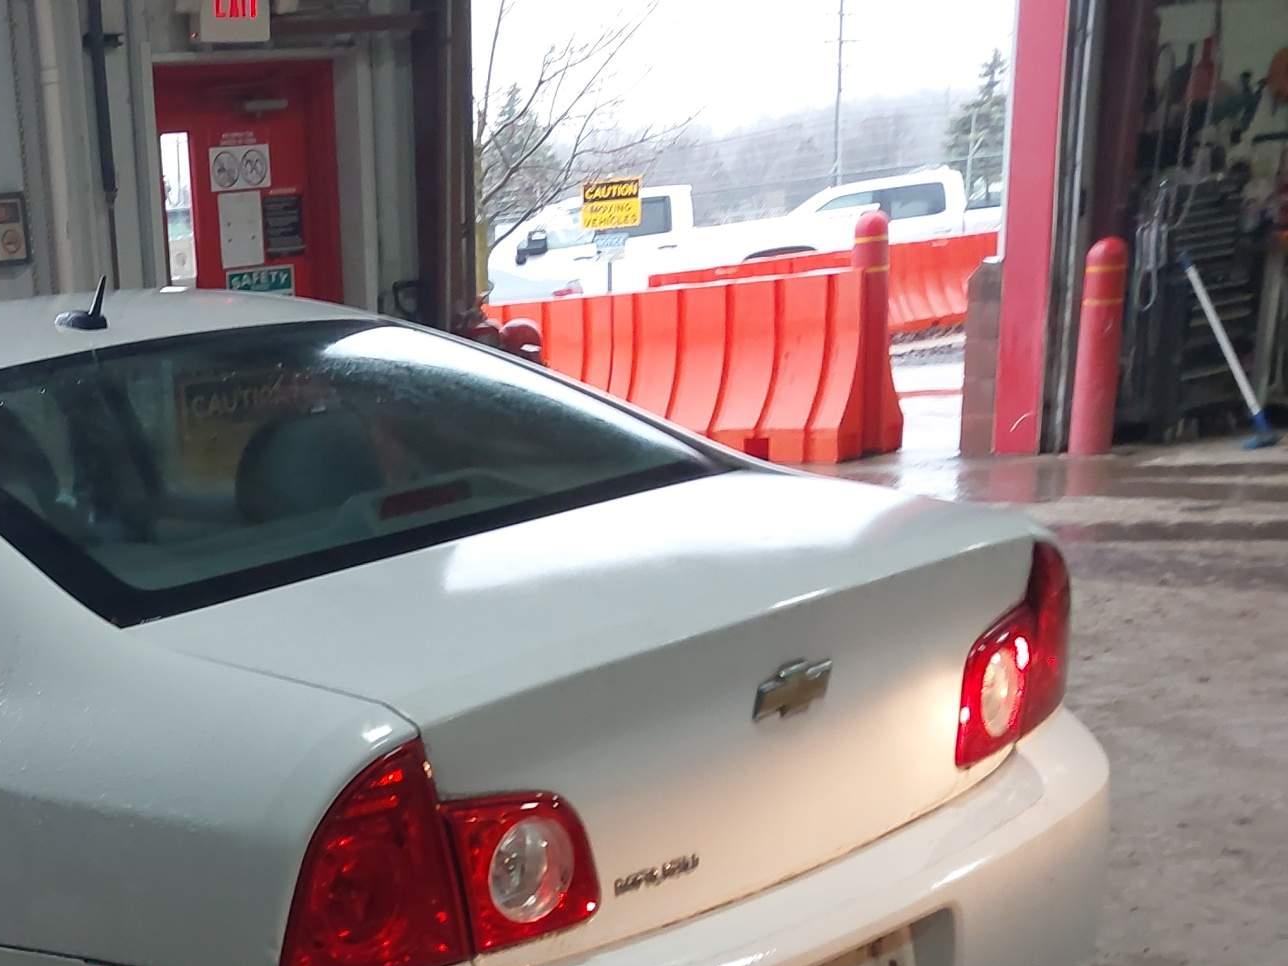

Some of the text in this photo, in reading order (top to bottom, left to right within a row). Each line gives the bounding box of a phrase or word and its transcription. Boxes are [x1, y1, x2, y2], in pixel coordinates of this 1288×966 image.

[584, 182, 638, 200] CAUTION
[590, 202, 632, 213] MOVING
[585, 214, 638, 227] VEHICLES
[231, 270, 289, 290] SAFETY
